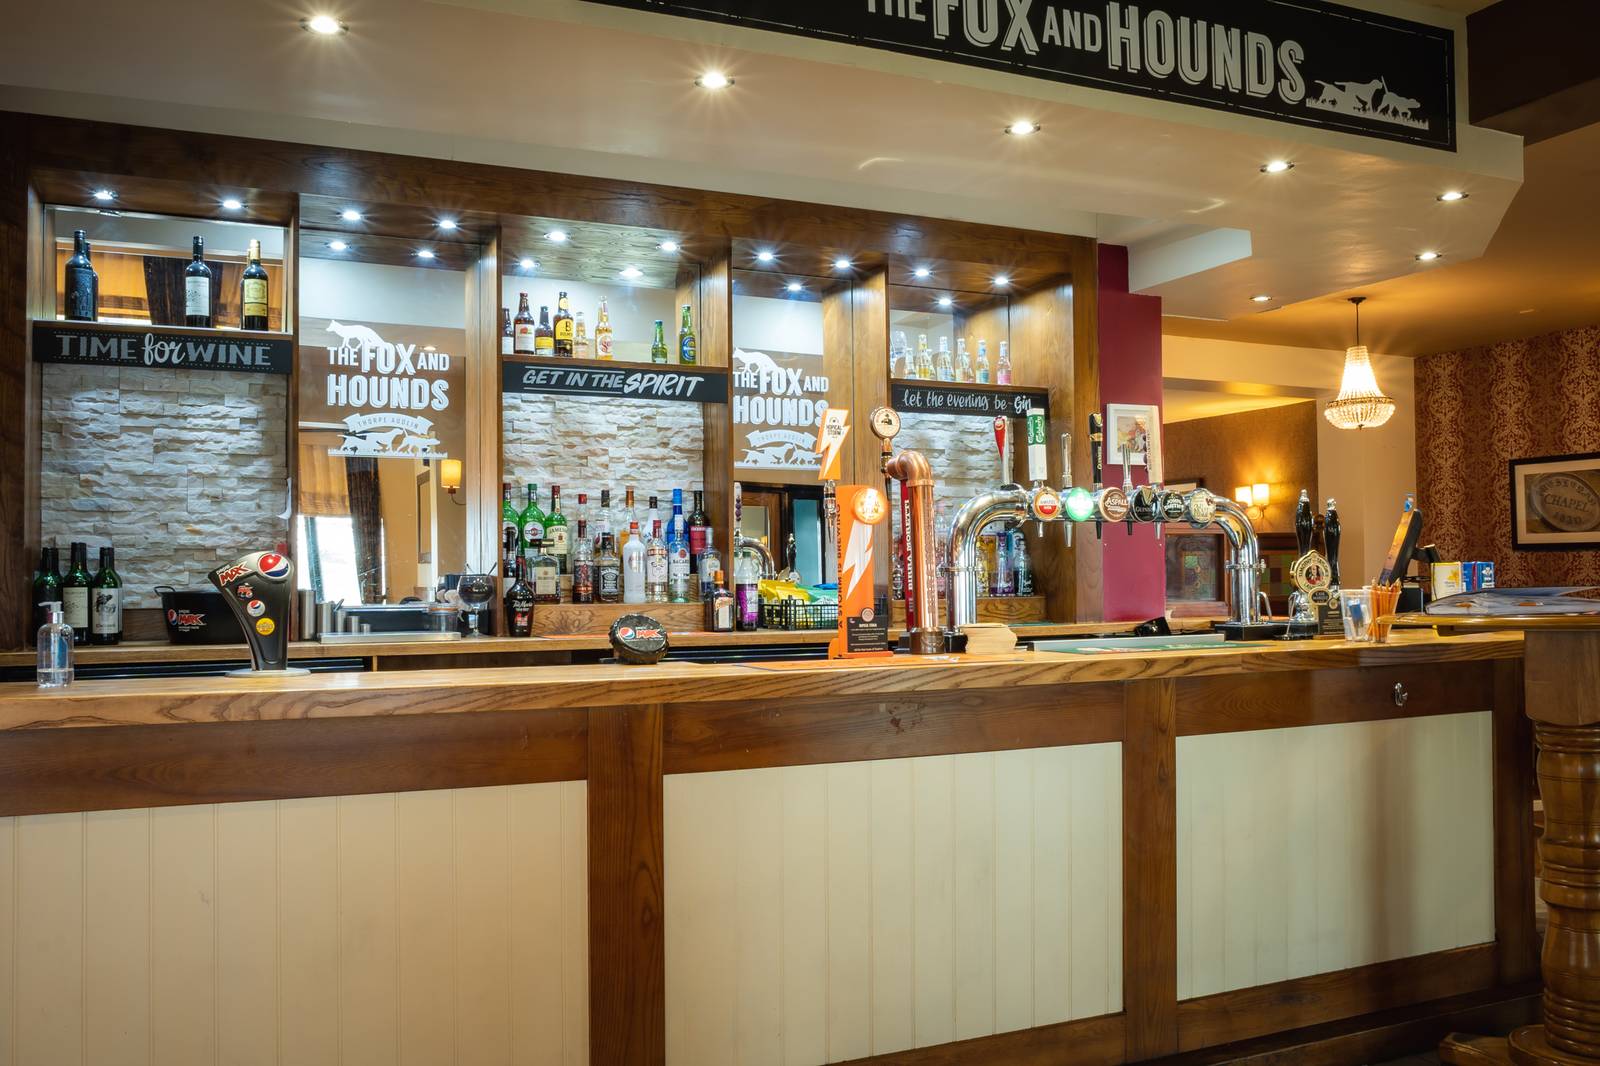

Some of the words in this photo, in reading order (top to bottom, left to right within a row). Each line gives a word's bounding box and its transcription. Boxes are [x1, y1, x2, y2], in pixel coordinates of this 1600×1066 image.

[1042, 5, 1102, 53] AND
[1106, 1, 1306, 105] HOUNDS
[56, 335, 137, 360] TIME
[142, 333, 186, 366] for
[186, 343, 271, 366] WINE
[327, 346, 359, 366] THE
[361, 338, 416, 375] FOX
[417, 352, 450, 371] AND
[327, 373, 449, 411] HOUNDS
[522, 370, 565, 385] GET
[565, 372, 588, 387] IN
[592, 374, 626, 389] THE
[623, 372, 705, 397] SPIRIT
[733, 371, 758, 388] THE
[759, 367, 803, 396] FOX
[803, 376, 829, 393] AND
[901, 388, 922, 407] let
[925, 391, 944, 407] the
[946, 394, 990, 411] evening
[1543, 493, 1589, 513] CHAPEL
[904, 500, 912, 551] MORETTI
[218, 561, 252, 587] MAX
[906, 555, 914, 590] BIRRA
